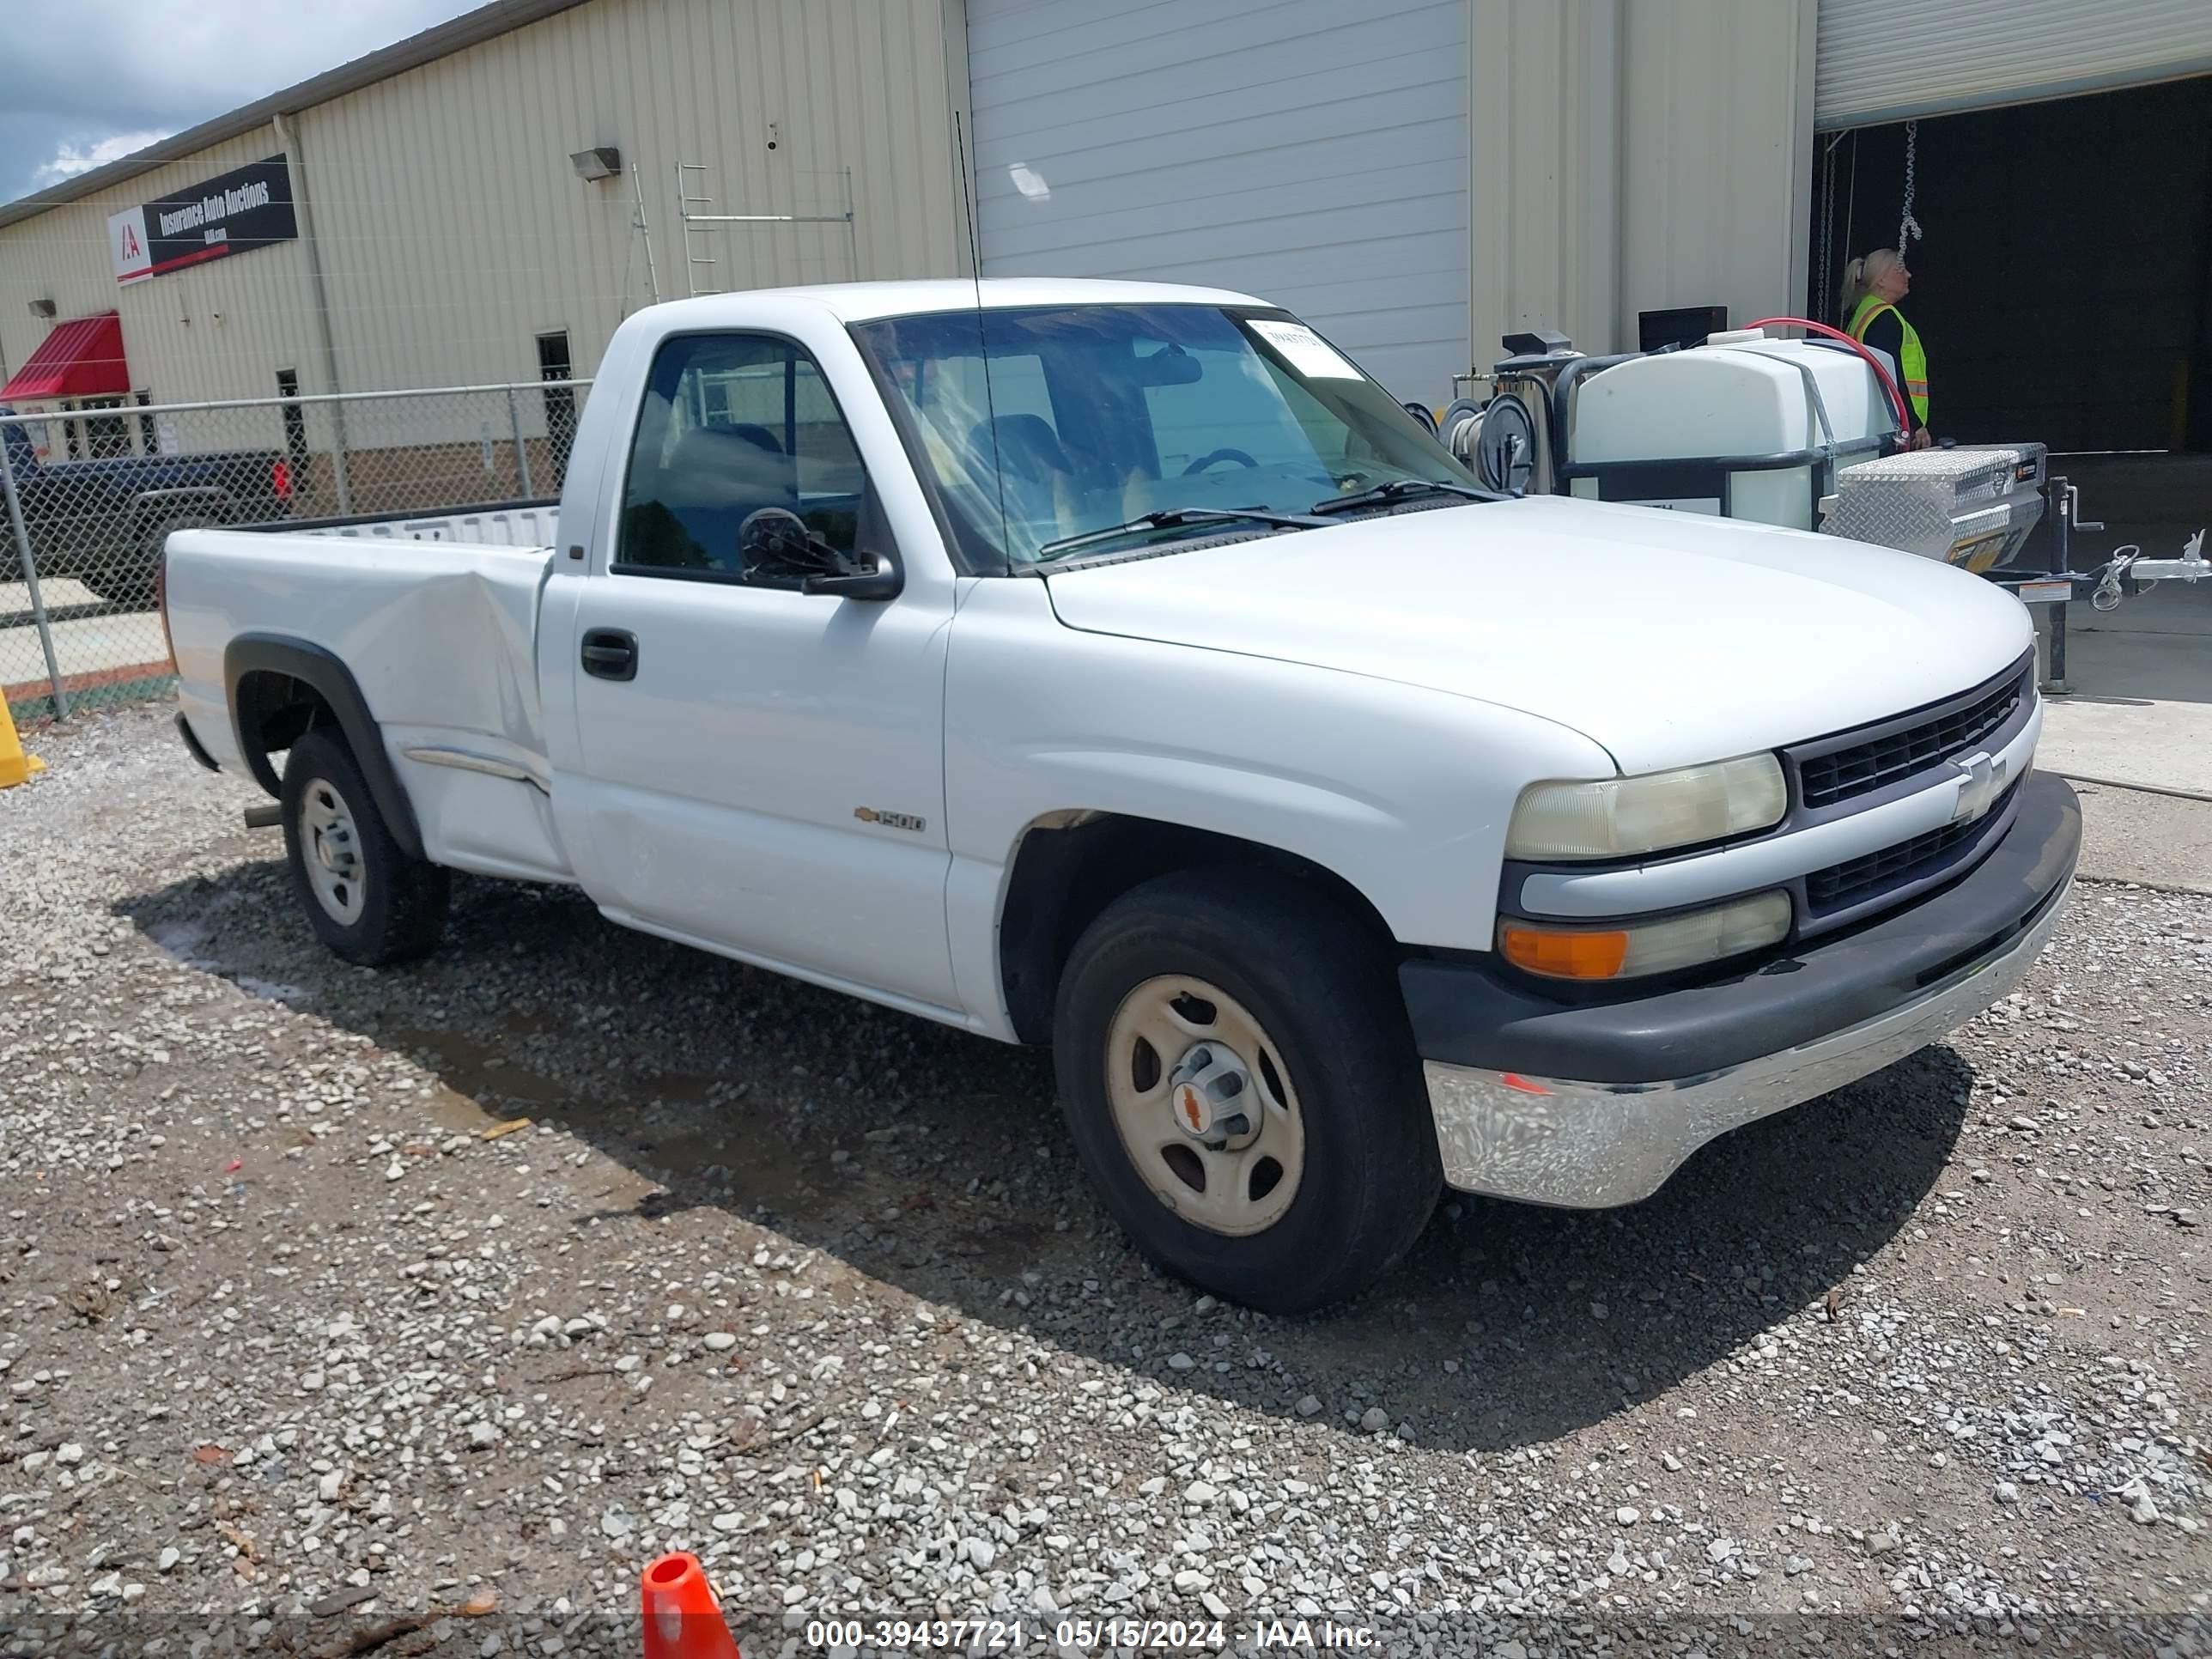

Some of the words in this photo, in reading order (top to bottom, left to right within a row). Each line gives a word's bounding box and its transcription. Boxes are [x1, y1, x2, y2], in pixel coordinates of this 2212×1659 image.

[159, 203, 204, 237] Insurance
[203, 194, 226, 223] Auto
[224, 180, 270, 216] Auctions
[878, 810, 927, 832] 1500
